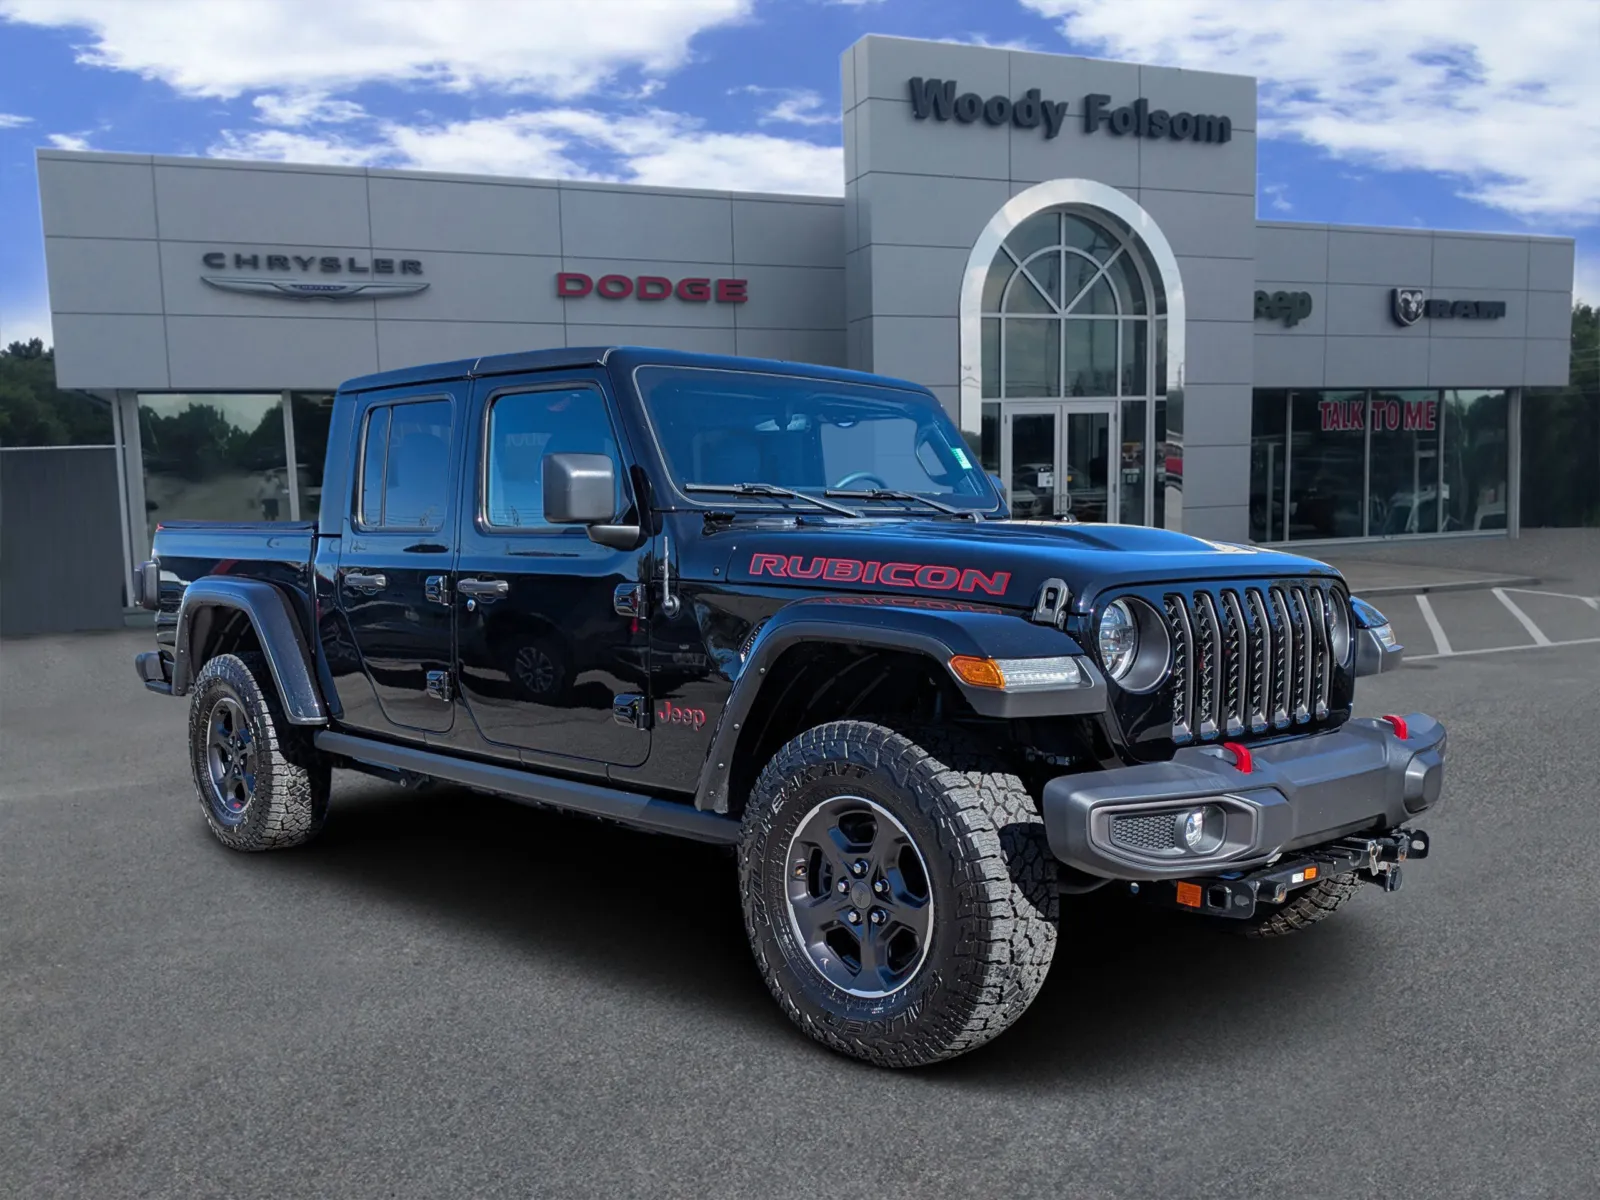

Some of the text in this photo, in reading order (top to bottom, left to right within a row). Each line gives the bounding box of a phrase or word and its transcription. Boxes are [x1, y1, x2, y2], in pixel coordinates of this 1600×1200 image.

[908, 76, 1232, 144] Woody Folsom
[202, 252, 424, 275] CHRYSLER
[557, 272, 749, 303] DODGE
[1254, 290, 1312, 328] eep
[1424, 299, 1507, 319] RAM
[1318, 400, 1437, 431] TALK TO ME
[749, 553, 1012, 596] RUBICON
[657, 701, 707, 732] Jeep
